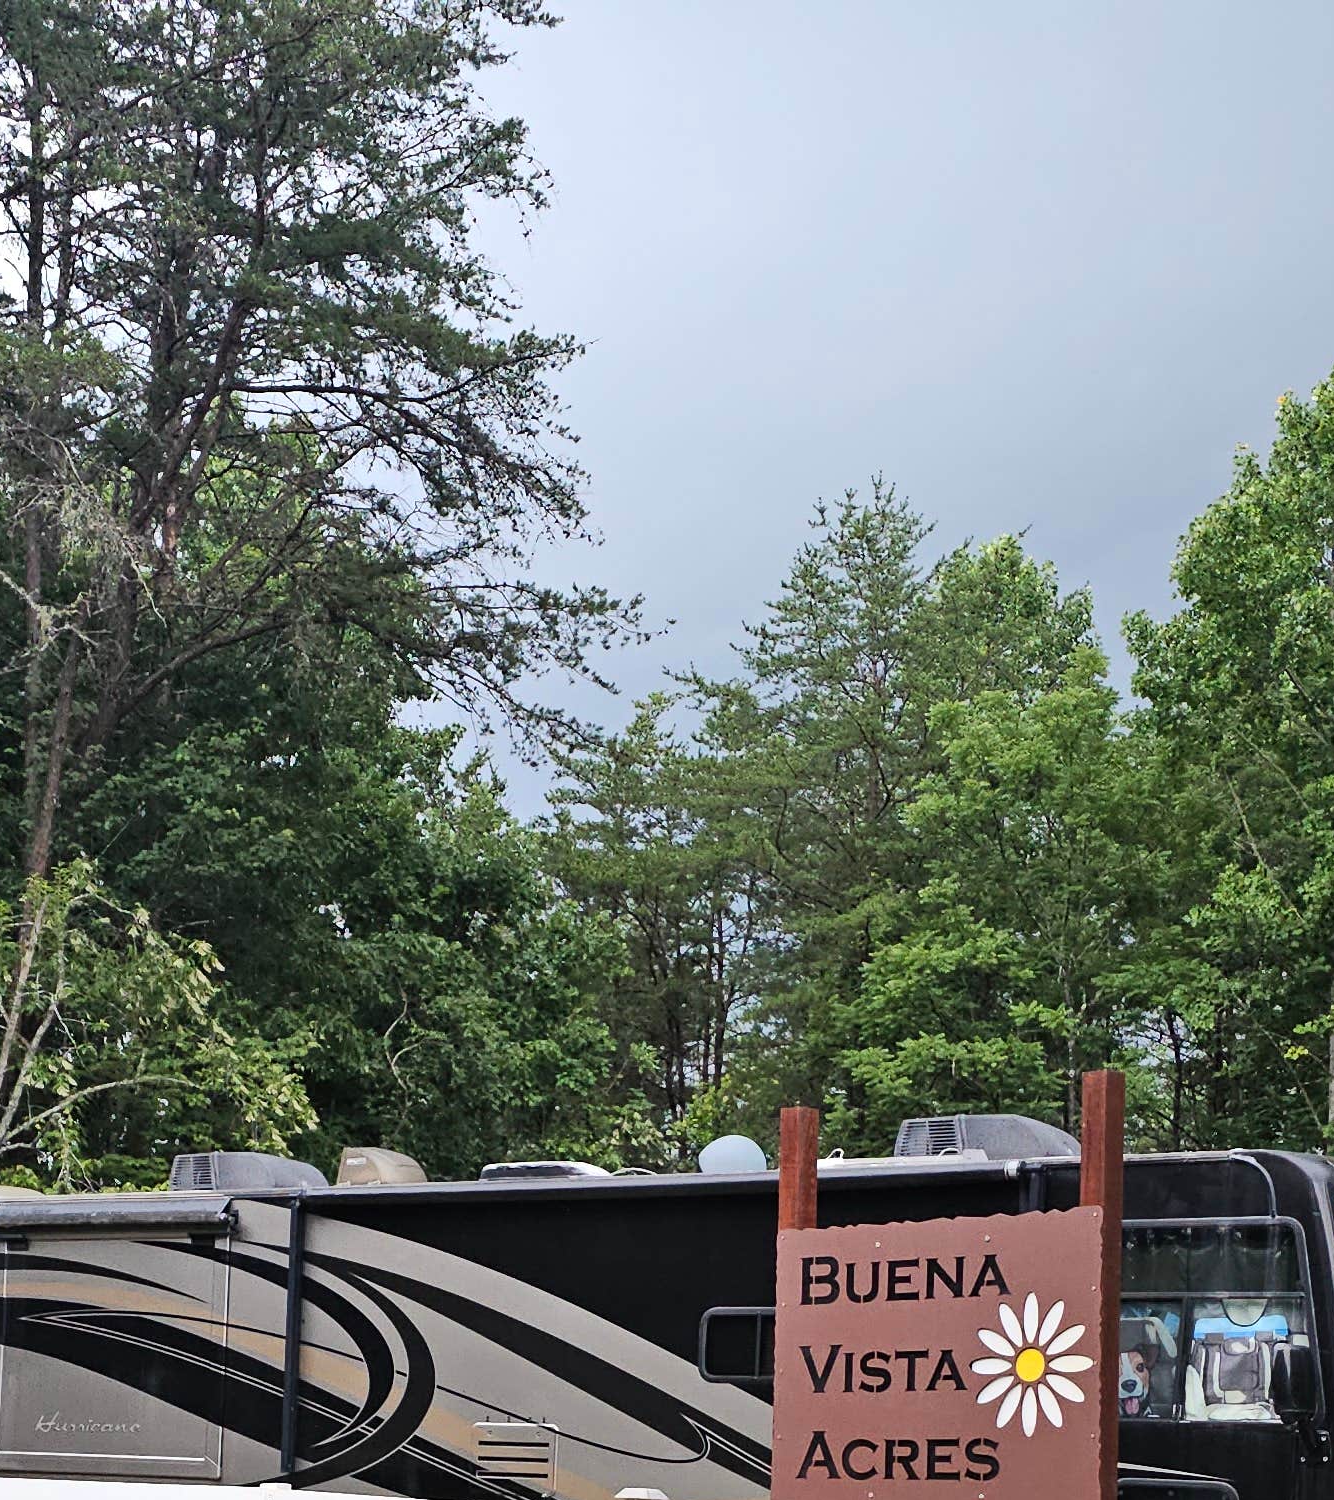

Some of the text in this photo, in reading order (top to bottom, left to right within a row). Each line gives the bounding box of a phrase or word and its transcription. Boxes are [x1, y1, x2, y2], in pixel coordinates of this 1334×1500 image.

[800, 1254, 1011, 1305] BUENA
[799, 1344, 967, 1393] VISTA
[796, 1430, 1000, 1481] ACRES
